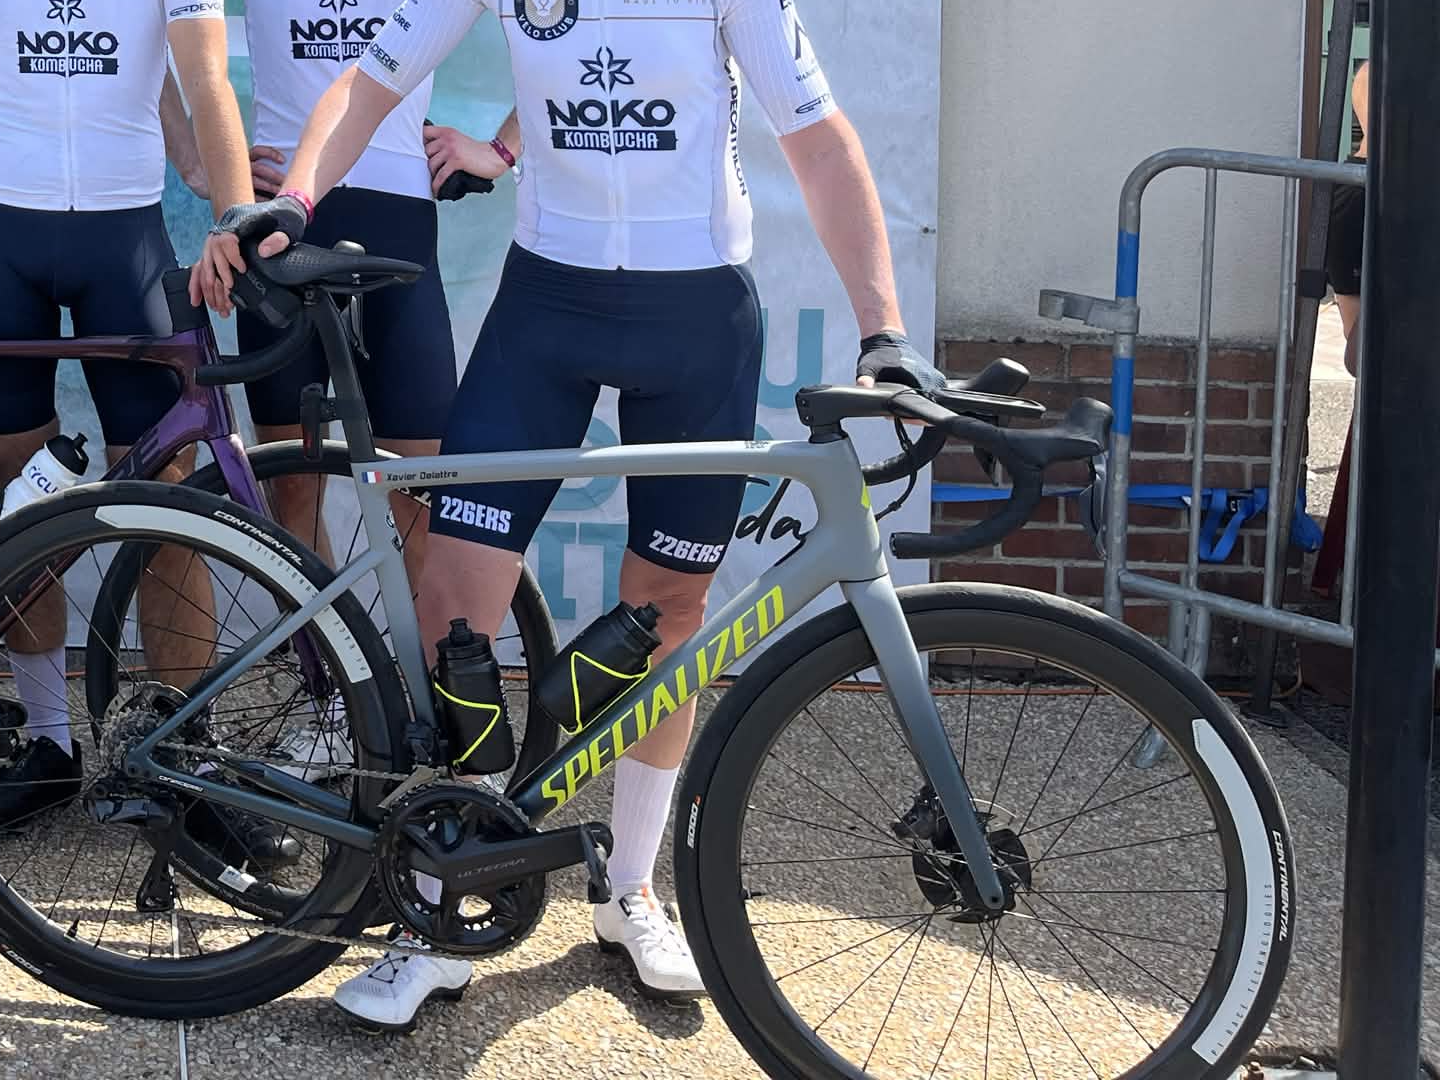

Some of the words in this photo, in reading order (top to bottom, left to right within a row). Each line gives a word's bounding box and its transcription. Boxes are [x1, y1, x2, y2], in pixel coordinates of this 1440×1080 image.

[517, 13, 541, 38] VELO
[544, 16, 574, 39] CLUB
[16, 30, 120, 56] NOKO
[30, 57, 103, 73] KOMBUCHA
[544, 98, 678, 128] NOKO
[565, 131, 658, 149] KOMBUCHA
[729, 84, 748, 197] DECATHLON
[386, 472, 417, 481] Xavier
[419, 470, 458, 481] Delattre
[439, 495, 512, 534] 226ERS
[213, 510, 305, 567] CONTINENTAL
[648, 529, 726, 565] 226ERS
[541, 584, 785, 818] SPECIALIZED
[1271, 830, 1290, 942] CONTINENTAL
